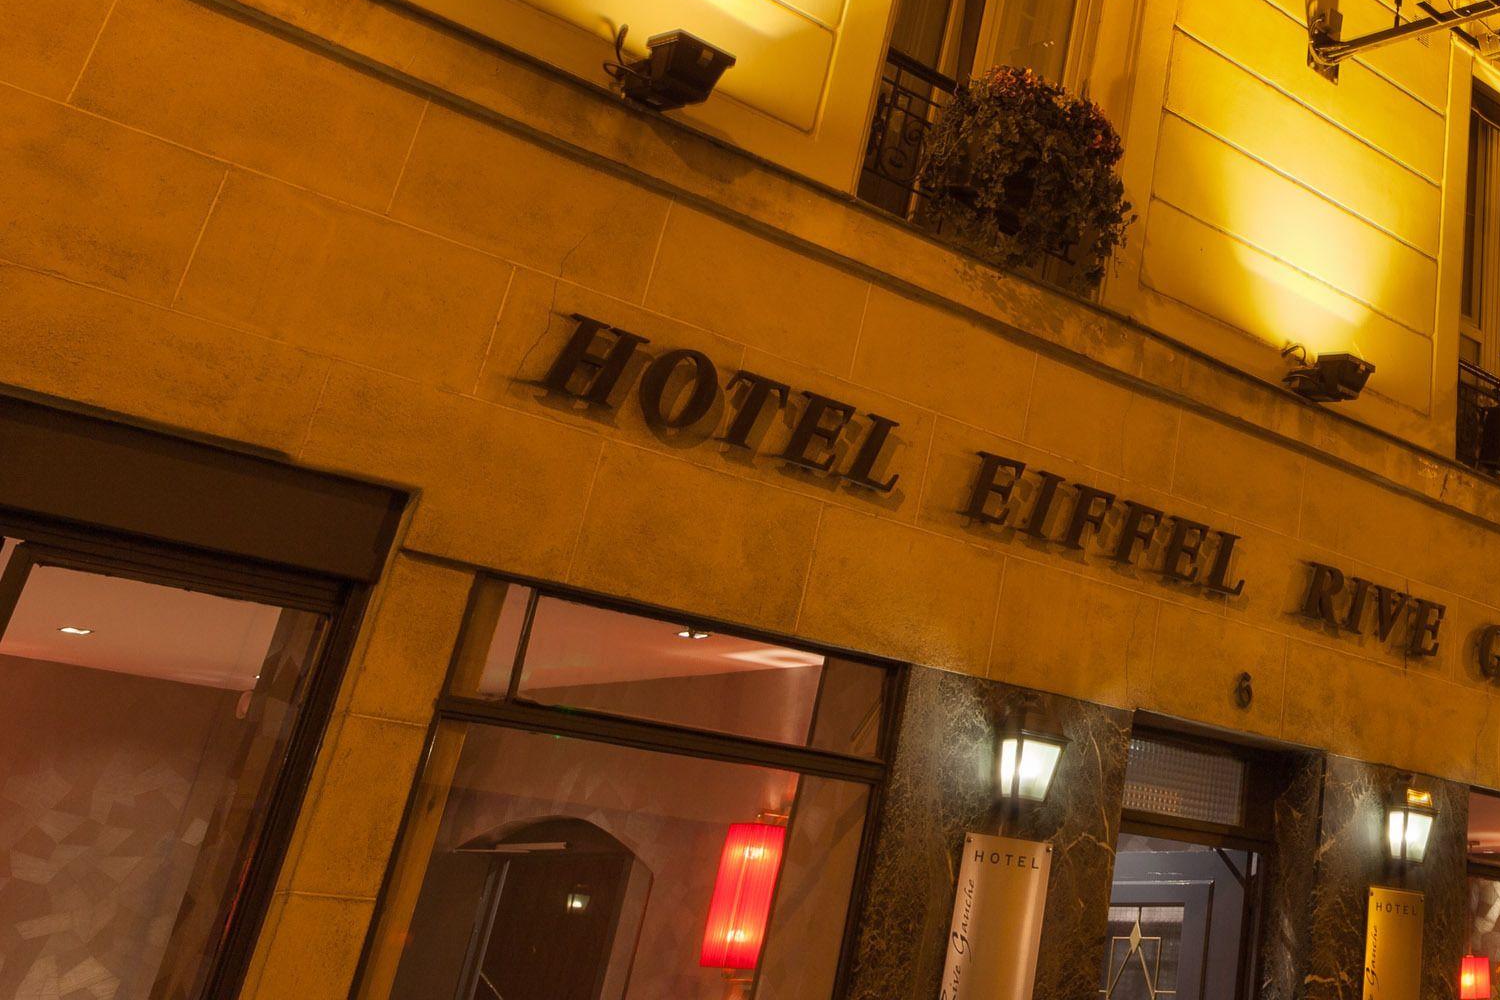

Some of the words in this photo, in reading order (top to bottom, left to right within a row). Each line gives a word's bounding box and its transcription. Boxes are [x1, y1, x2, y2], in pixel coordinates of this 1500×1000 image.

[539, 312, 901, 494] HOTEL
[956, 450, 1247, 597] EIFFEL
[1301, 560, 1448, 658] RIVE
[1237, 671, 1253, 710] 6
[974, 850, 1040, 870] HOTEL
[952, 879, 975, 963] Gauche
[1375, 902, 1418, 917] HOTEL
